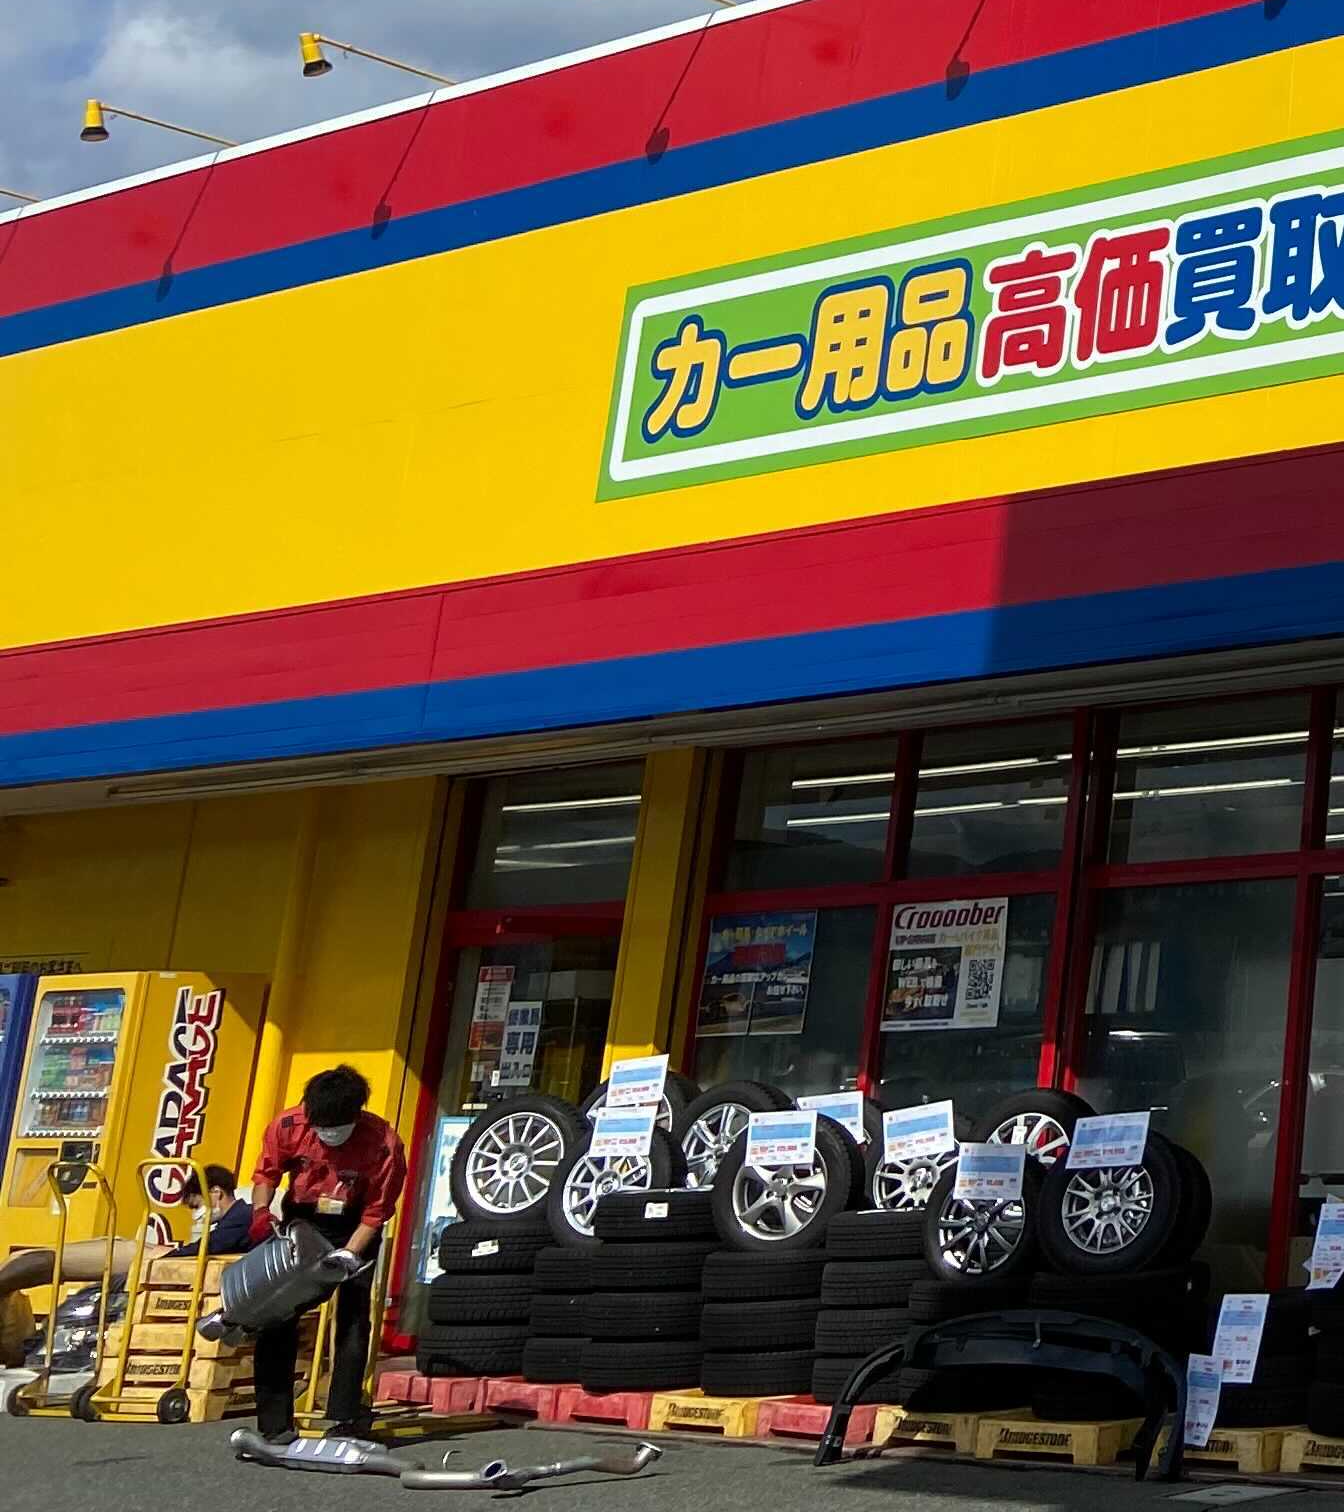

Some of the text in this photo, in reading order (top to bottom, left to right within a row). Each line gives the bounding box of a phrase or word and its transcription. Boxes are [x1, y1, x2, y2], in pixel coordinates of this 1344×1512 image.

[895, 902, 1005, 929] Croooober
[146, 986, 226, 1206] GARAGE
[999, 1427, 1072, 1447] BRIDGESTONE
